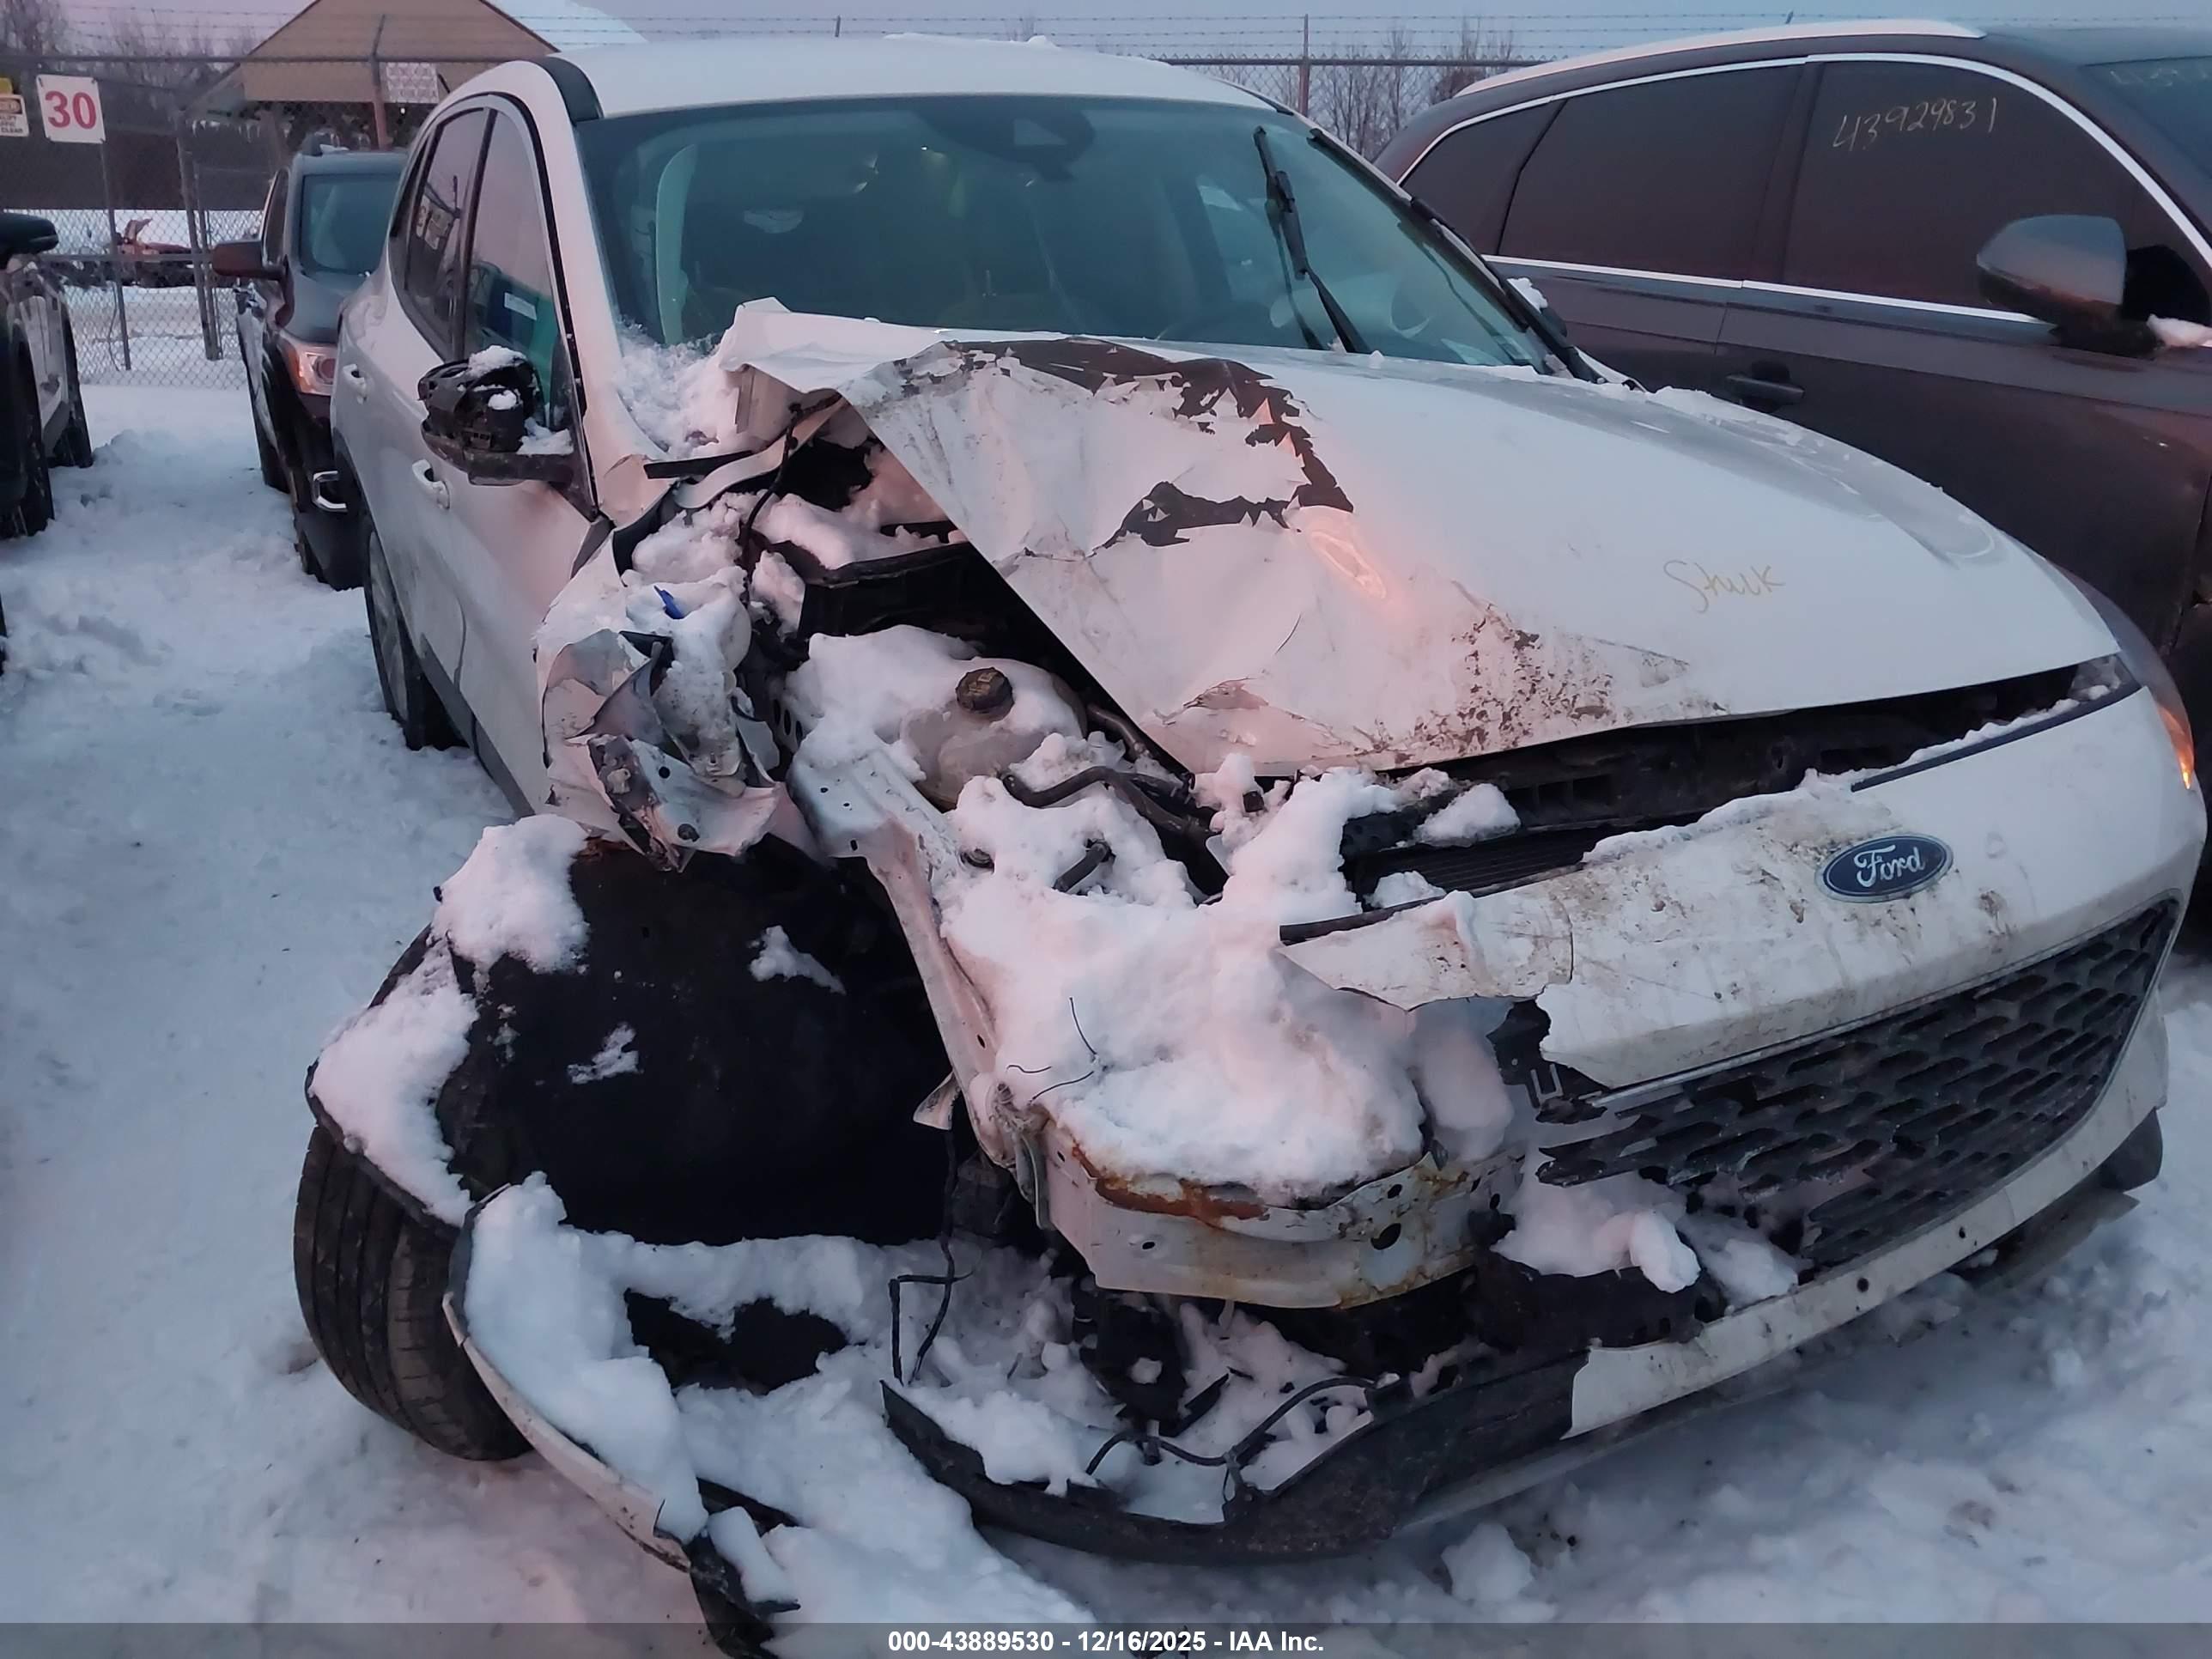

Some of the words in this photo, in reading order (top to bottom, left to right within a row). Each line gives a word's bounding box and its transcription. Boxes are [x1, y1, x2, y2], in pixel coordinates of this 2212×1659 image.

[45, 90, 97, 130] 30
[1832, 97, 1997, 151] 43929831
[1853, 844, 1925, 888] Ford
